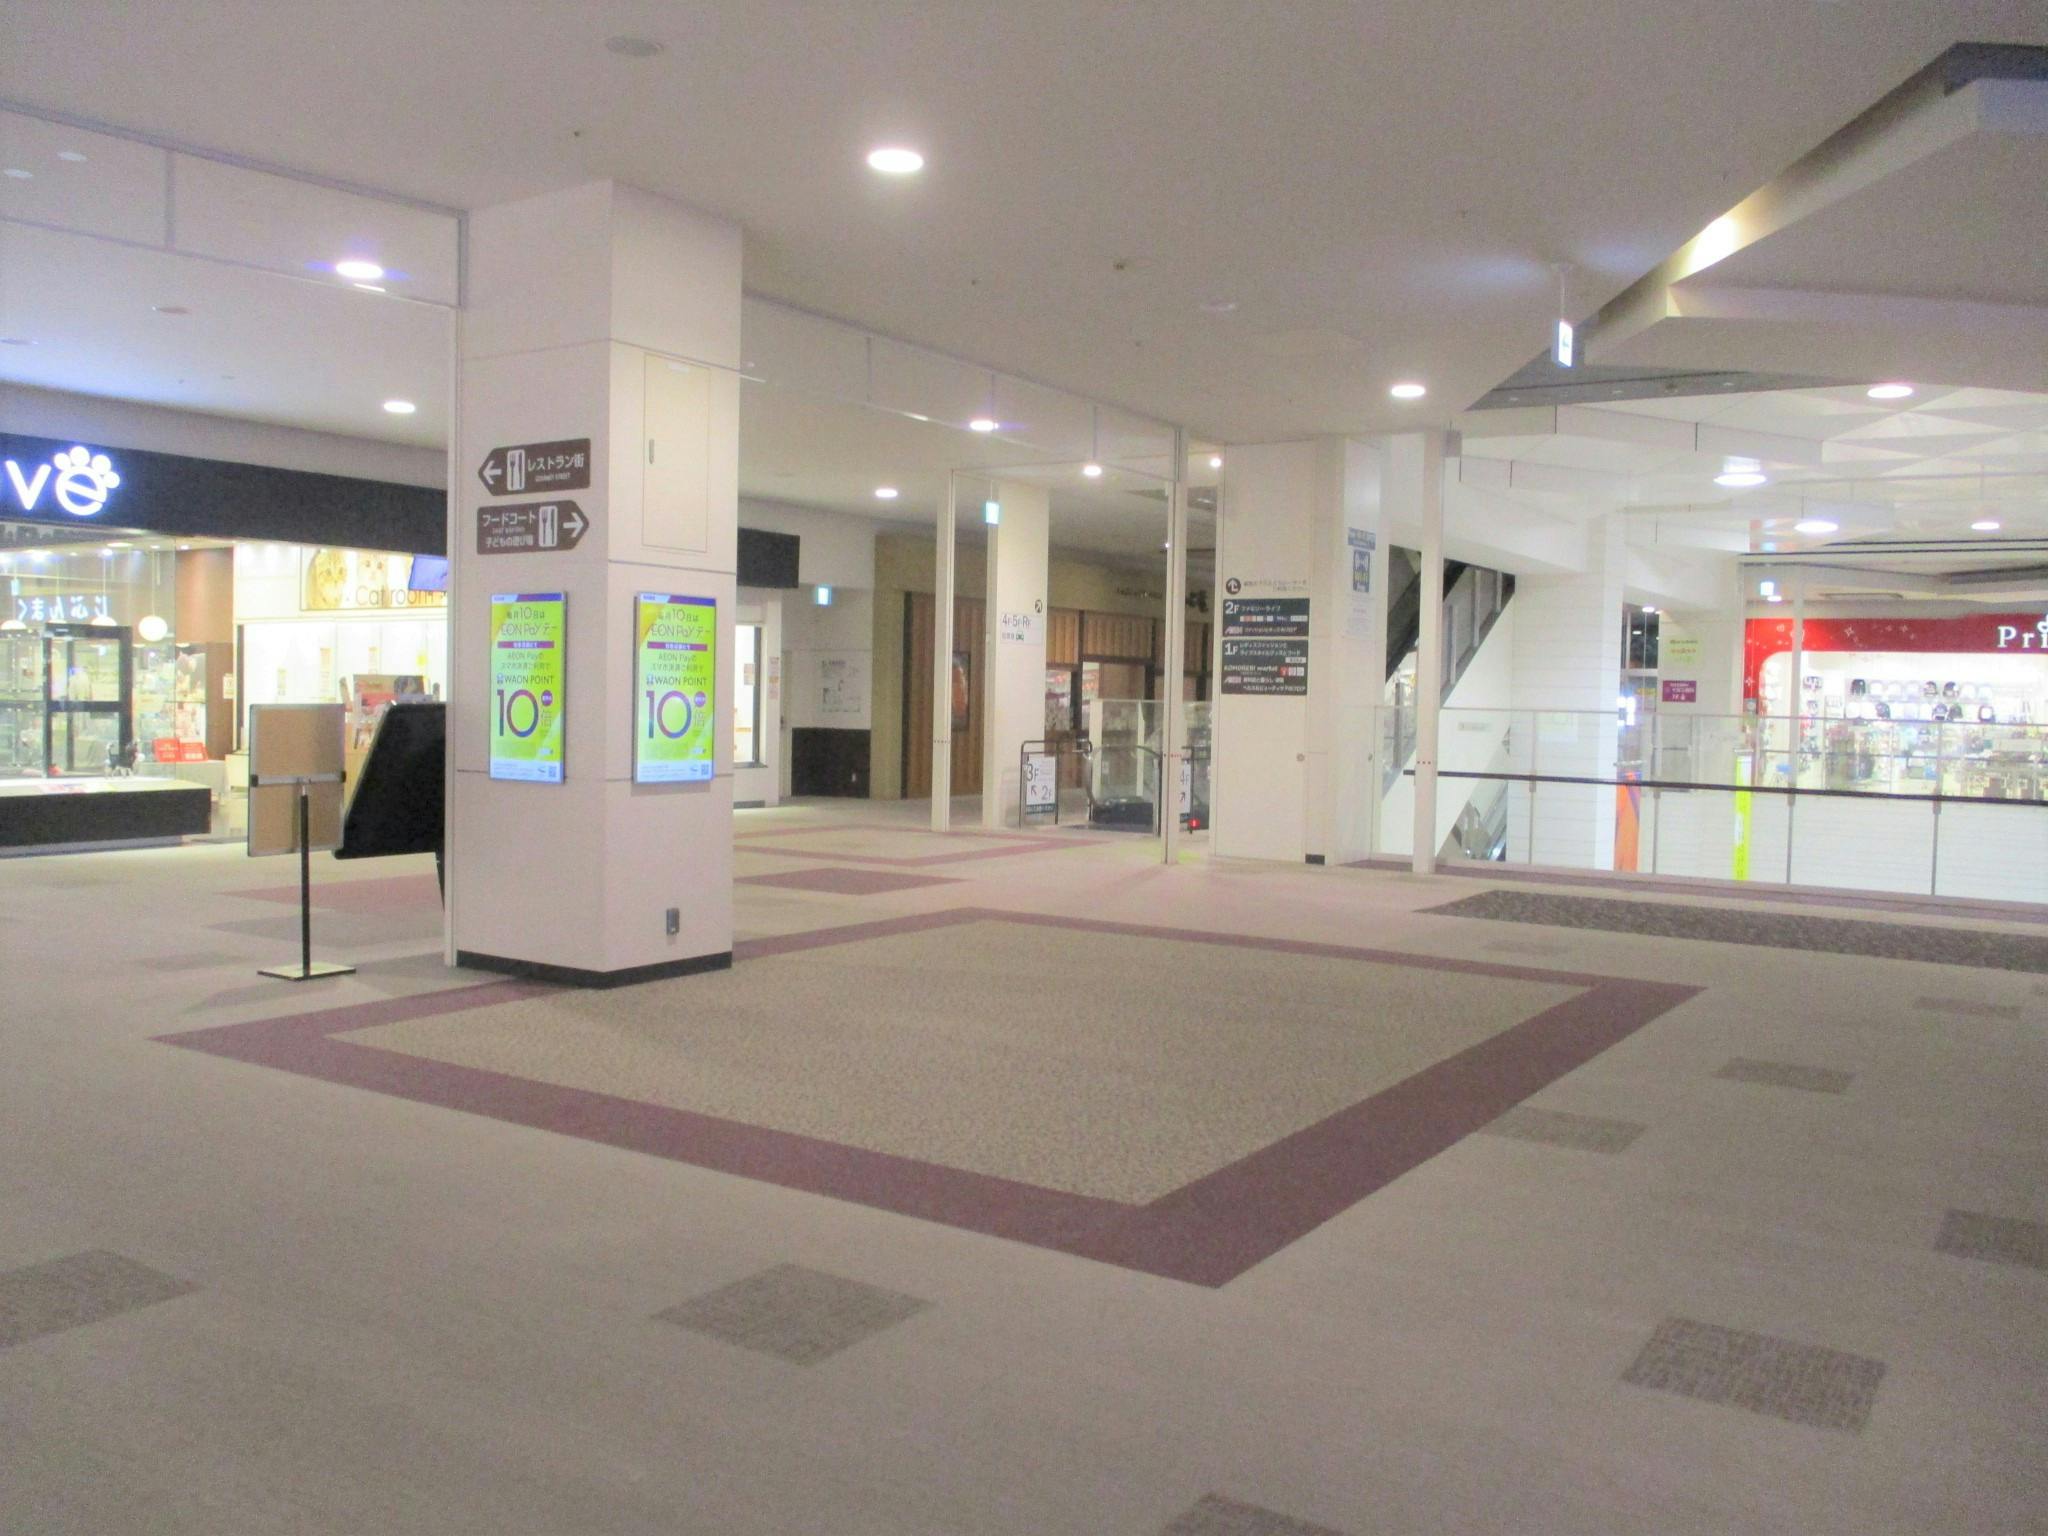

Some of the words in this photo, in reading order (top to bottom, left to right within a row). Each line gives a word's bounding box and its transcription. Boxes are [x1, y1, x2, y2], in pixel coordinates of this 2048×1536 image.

[527, 452, 585, 472] レストラン街
[482, 510, 537, 527] フードコート
[355, 585, 386, 605] Cat
[1225, 601, 1240, 614] 2F
[1224, 642, 1238, 656] 1F
[504, 675, 528, 684] WAON
[530, 675, 554, 685] POINT
[655, 676, 680, 685] WAON
[683, 676, 707, 686] POINT
[496, 689, 539, 738] 10
[646, 690, 692, 739] 10
[1026, 763, 1039, 782] 3F
